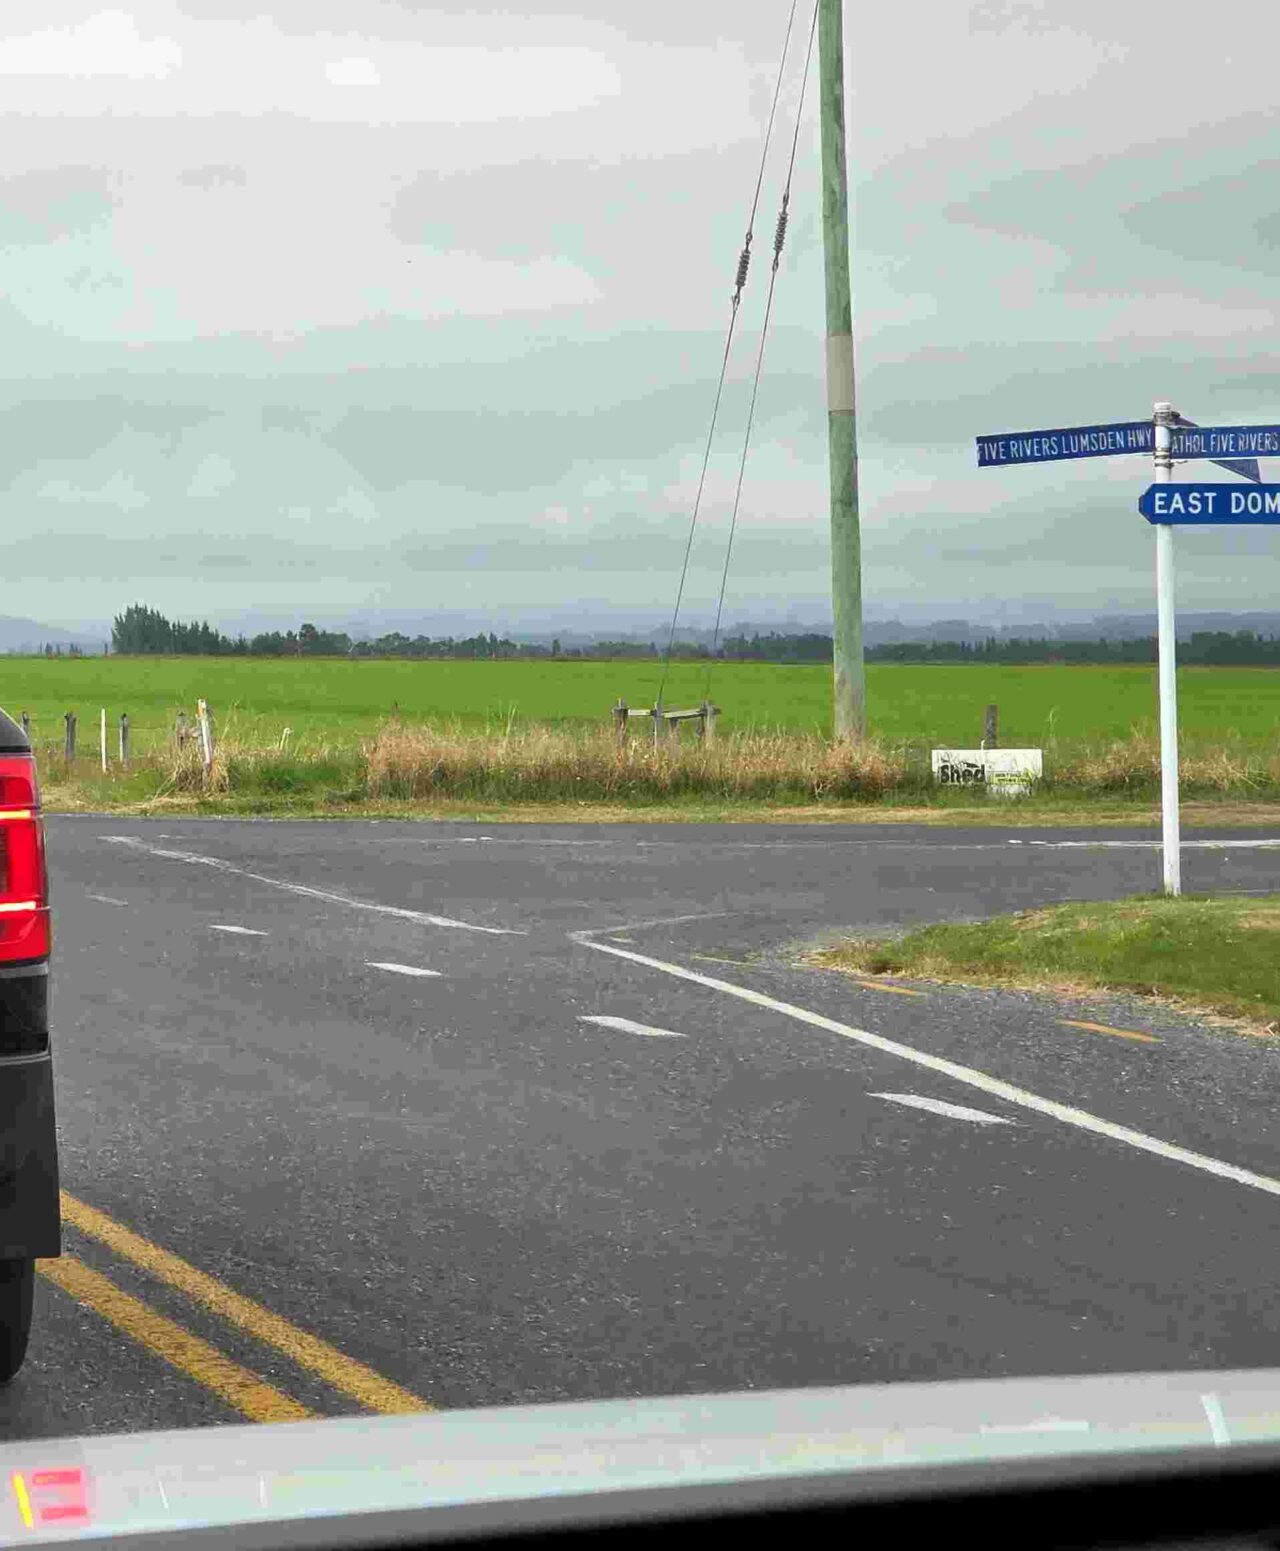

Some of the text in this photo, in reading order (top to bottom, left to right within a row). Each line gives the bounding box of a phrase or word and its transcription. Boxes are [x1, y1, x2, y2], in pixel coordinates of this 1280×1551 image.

[977, 428, 1152, 461] FIVE RIVERS LUMSDEN HWY
[1210, 433, 1235, 452] FIVE
[1238, 432, 1278, 452] RIVERS
[1154, 492, 1280, 514] EAST DOM
[940, 764, 985, 783] Shed
